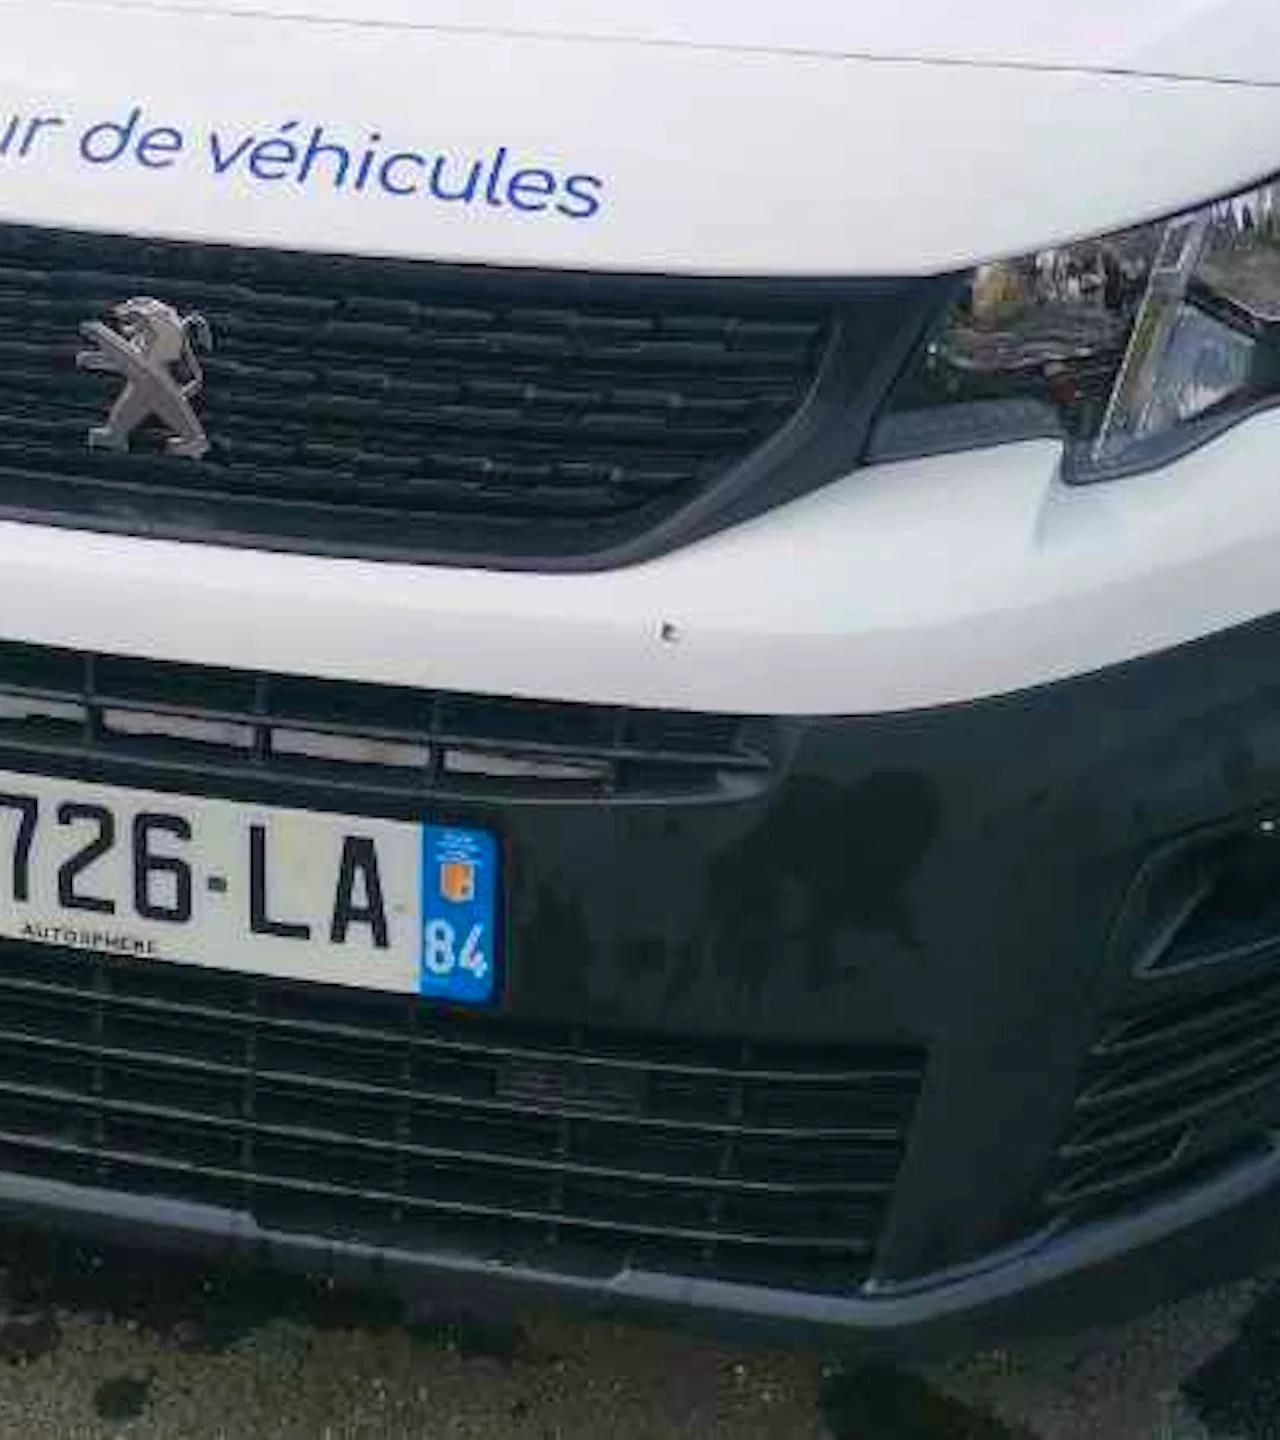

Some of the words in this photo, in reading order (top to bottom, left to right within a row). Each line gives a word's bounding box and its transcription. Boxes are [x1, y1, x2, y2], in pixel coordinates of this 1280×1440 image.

[78, 106, 185, 170] de
[208, 119, 605, 220] véhicules
[424, 918, 489, 980] 84
